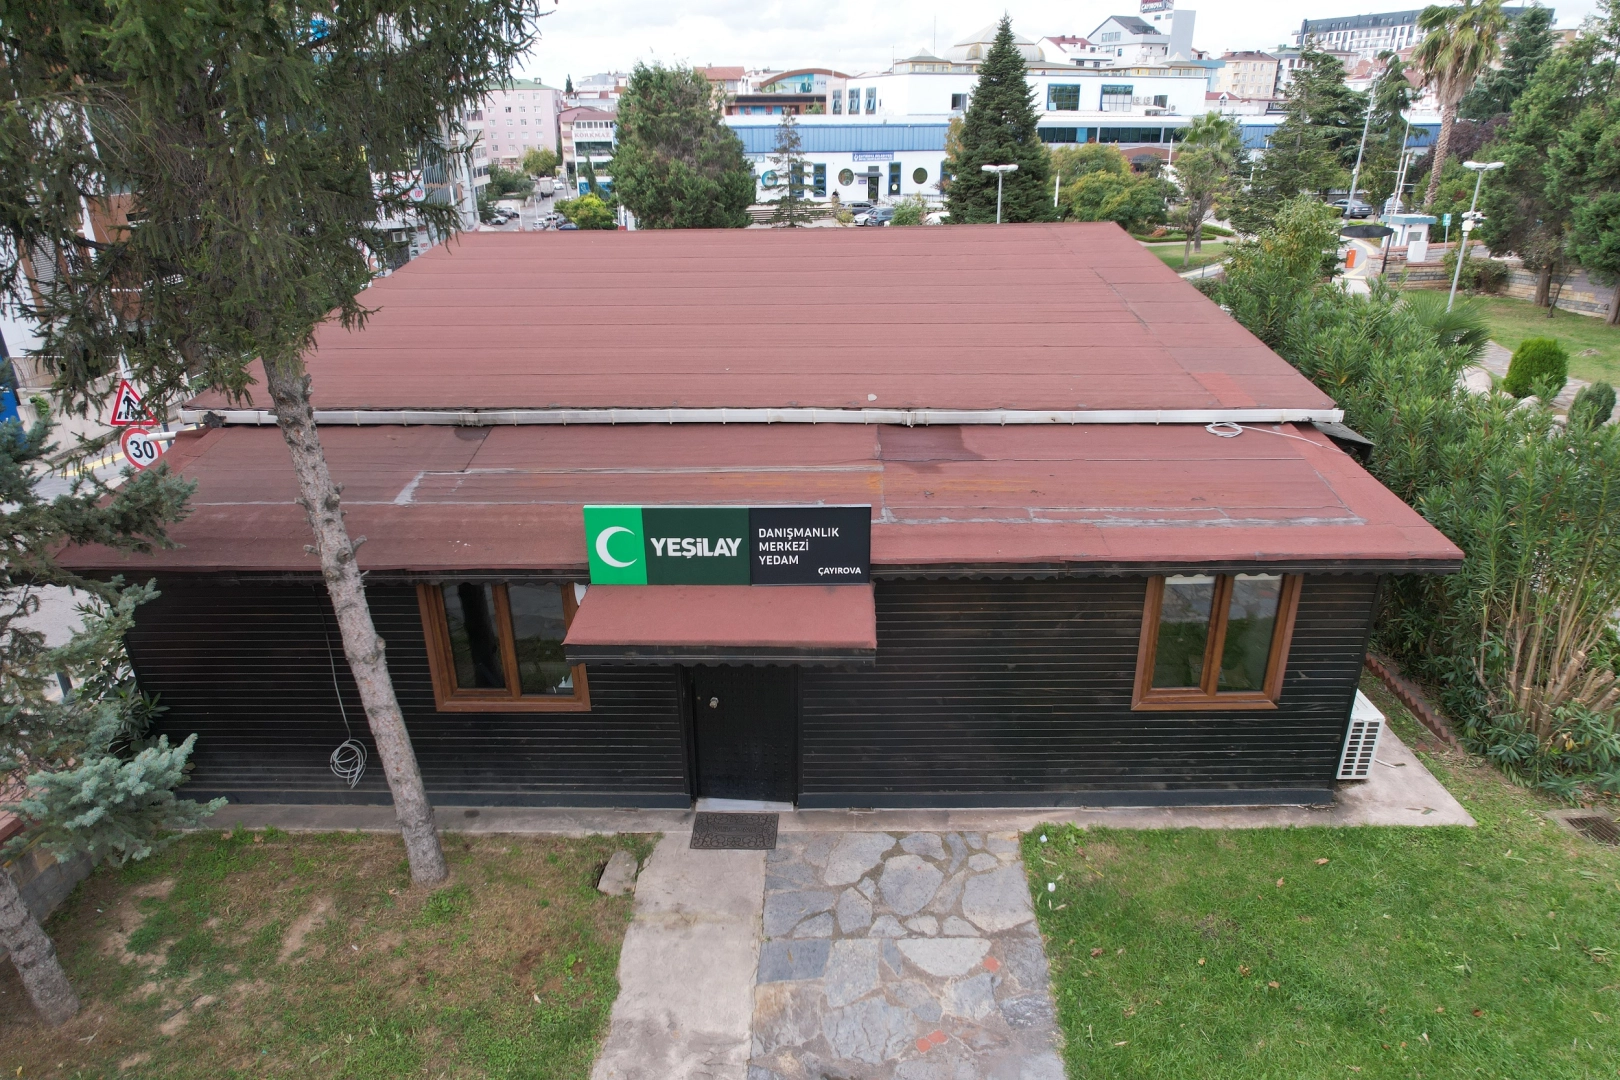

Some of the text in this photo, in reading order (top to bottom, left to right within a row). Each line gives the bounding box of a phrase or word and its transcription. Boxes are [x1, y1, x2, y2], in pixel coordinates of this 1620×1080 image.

[130, 440, 155, 459] 30
[758, 527, 839, 540] DANIŞMANLIK
[759, 539, 809, 552] MERKEZİ
[759, 555, 799, 565] YEDAM
[817, 567, 861, 576] ÇAYIROVA
